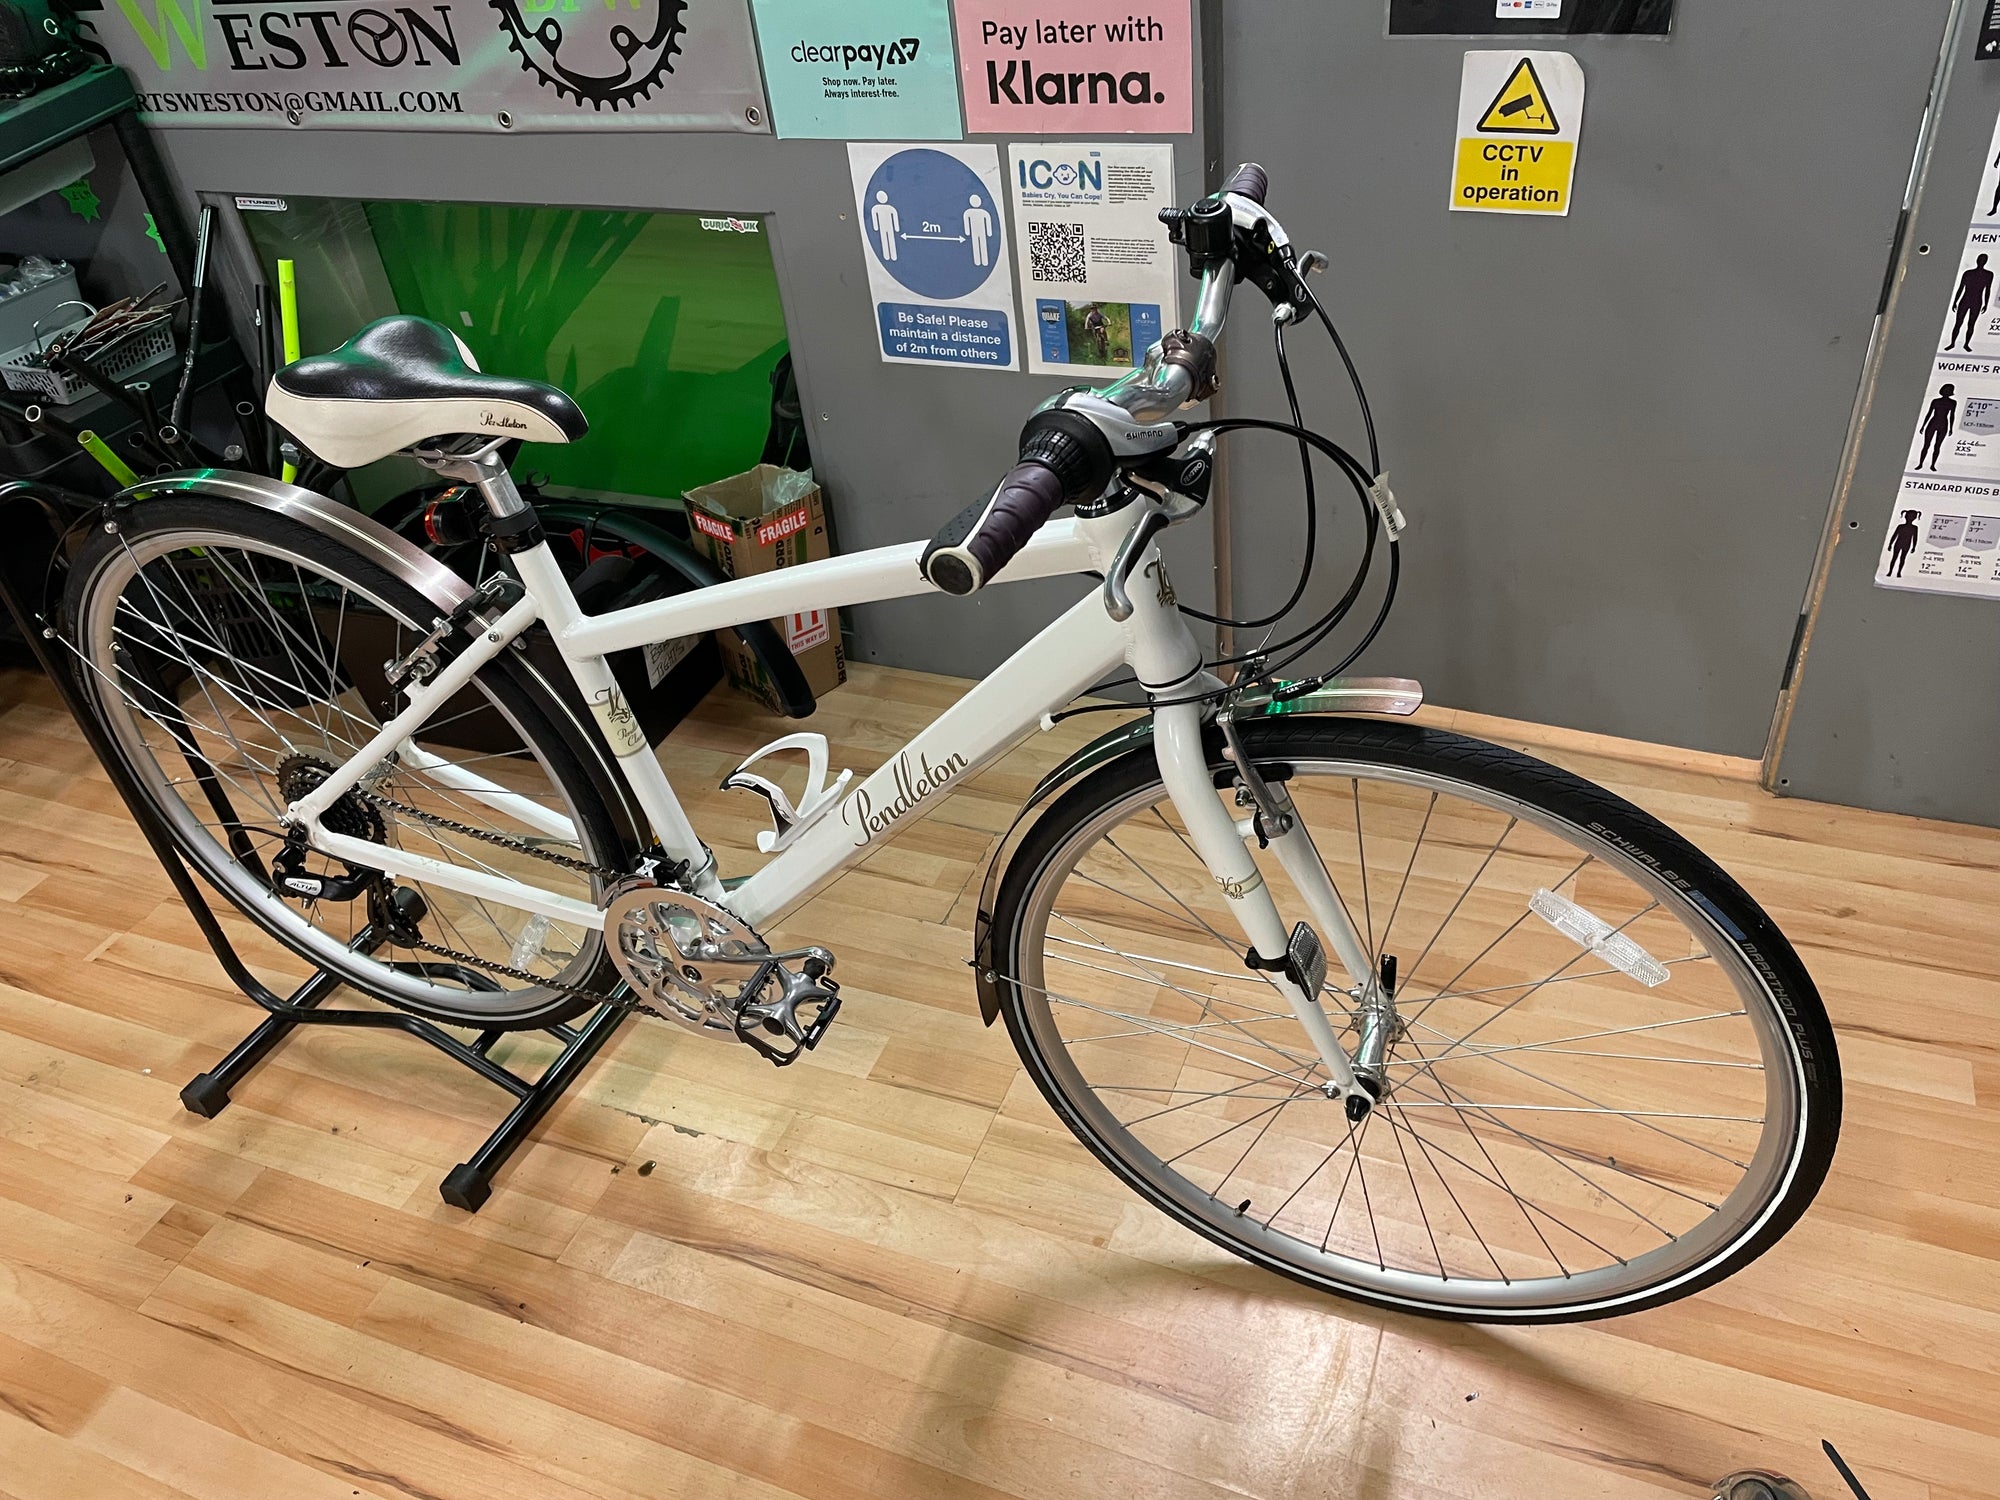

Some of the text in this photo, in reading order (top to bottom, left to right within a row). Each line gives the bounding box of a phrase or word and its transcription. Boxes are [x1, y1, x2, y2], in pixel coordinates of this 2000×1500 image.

[982, 16, 1163, 50] Pay later with
[791, 39, 885, 71] clearpay
[822, 76, 897, 87] Shop now. Pay later.
[986, 60, 1165, 105] Klarna.
[824, 89, 899, 99] Always interest-free.
[1483, 144, 1544, 162] CCTV
[1501, 165, 1519, 181] in
[1022, 191, 1043, 199] Babies
[1084, 193, 1103, 201] Cope!
[1463, 185, 1559, 203] operation
[922, 221, 941, 233] 2m
[898, 312, 988, 329] Be Safe! Please
[889, 328, 1001, 345] maintain a distance
[896, 342, 998, 360] of 2m from others
[1938, 362, 1990, 373] WOMEN'S
[1125, 430, 1163, 440] SHIMANO
[1905, 481, 1962, 493] STANDARD
[1964, 486, 1990, 495] KIDS
[695, 514, 734, 542] FRAGILE
[759, 511, 807, 545] FRAGILE
[791, 630, 826, 651] THIS WAY UP
[842, 750, 968, 847] Pendleton
[1586, 821, 1691, 890] SCHWALBE
[1742, 942, 1814, 1060] MARATHON PLUS
